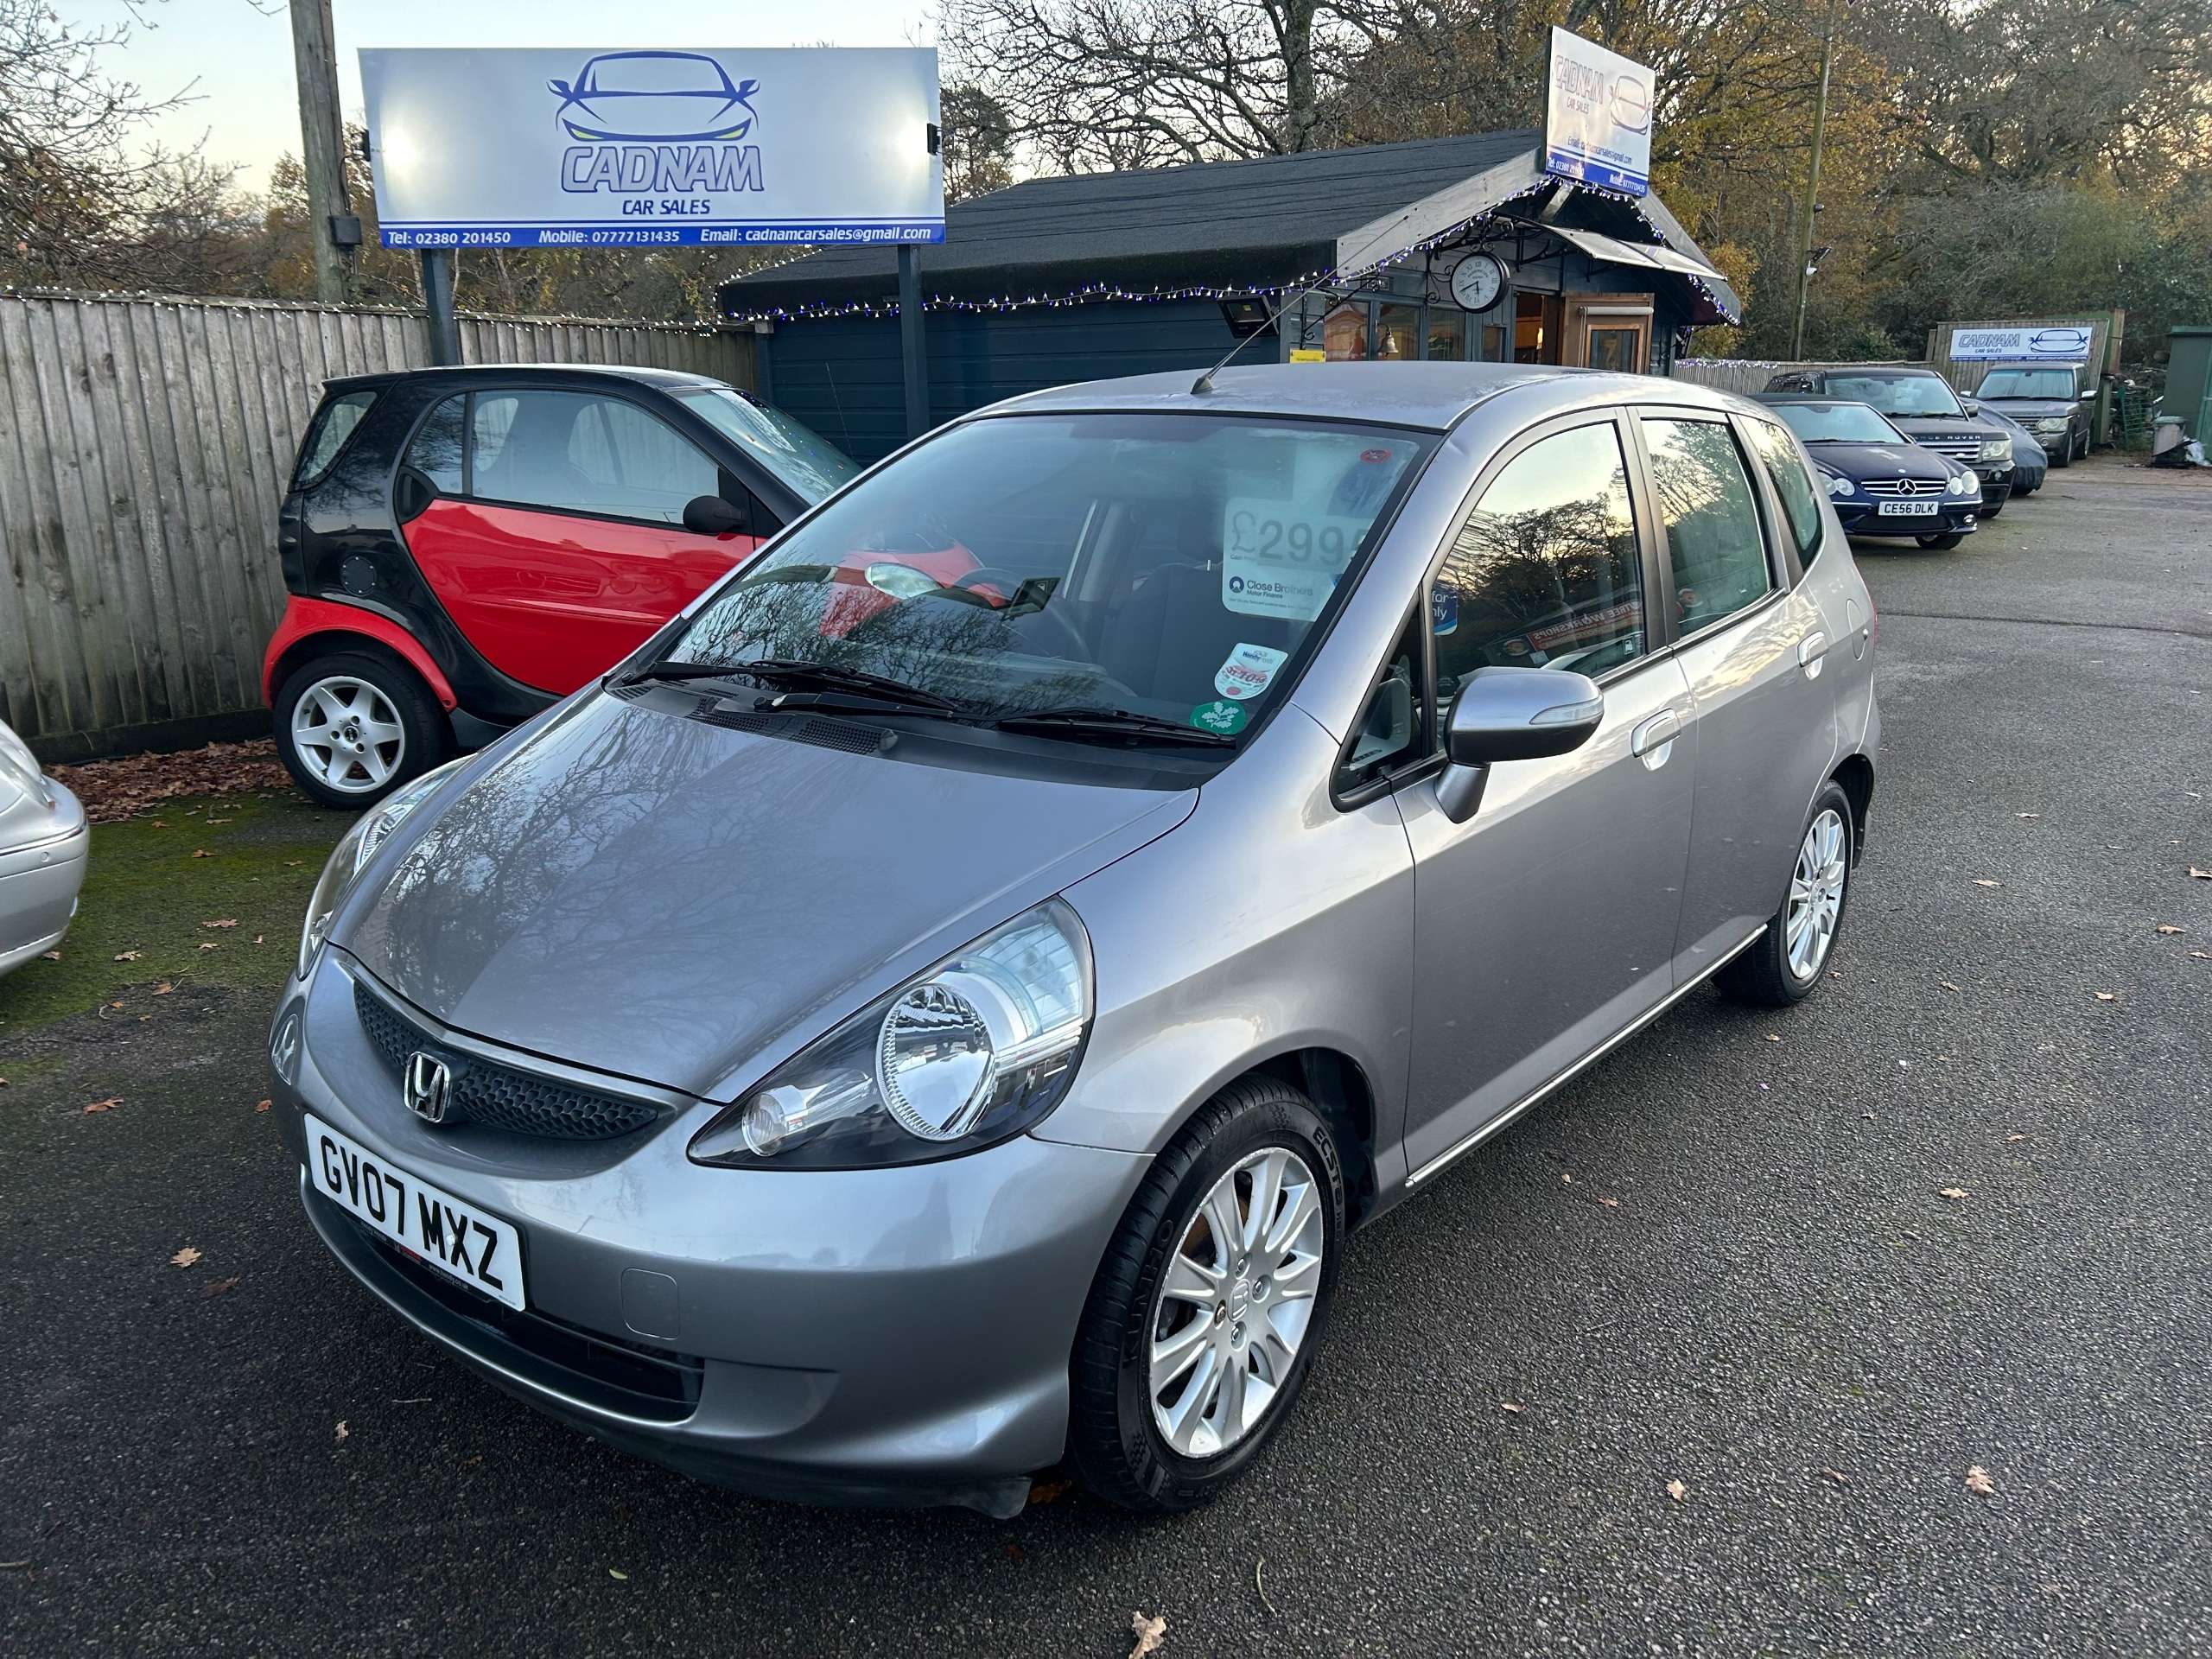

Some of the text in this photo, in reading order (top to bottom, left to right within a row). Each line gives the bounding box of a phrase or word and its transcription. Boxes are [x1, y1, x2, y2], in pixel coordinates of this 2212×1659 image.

[1554, 54, 1604, 105] CADNAM
[562, 145, 765, 193] CADNAM
[622, 199, 710, 215] CAR SALES
[388, 232, 512, 245] Tel: 02380 201450
[538, 229, 680, 244] Mobile: 07777131435
[700, 226, 931, 245] Email: cadnamcarsales@gmail.com
[1959, 334, 2020, 347] CADNAM
[1884, 503, 1935, 514] CE56 DLK
[1247, 580, 1273, 592] Close
[1431, 606, 1447, 620] nly
[321, 1134, 504, 1292] GV07 MXZ
